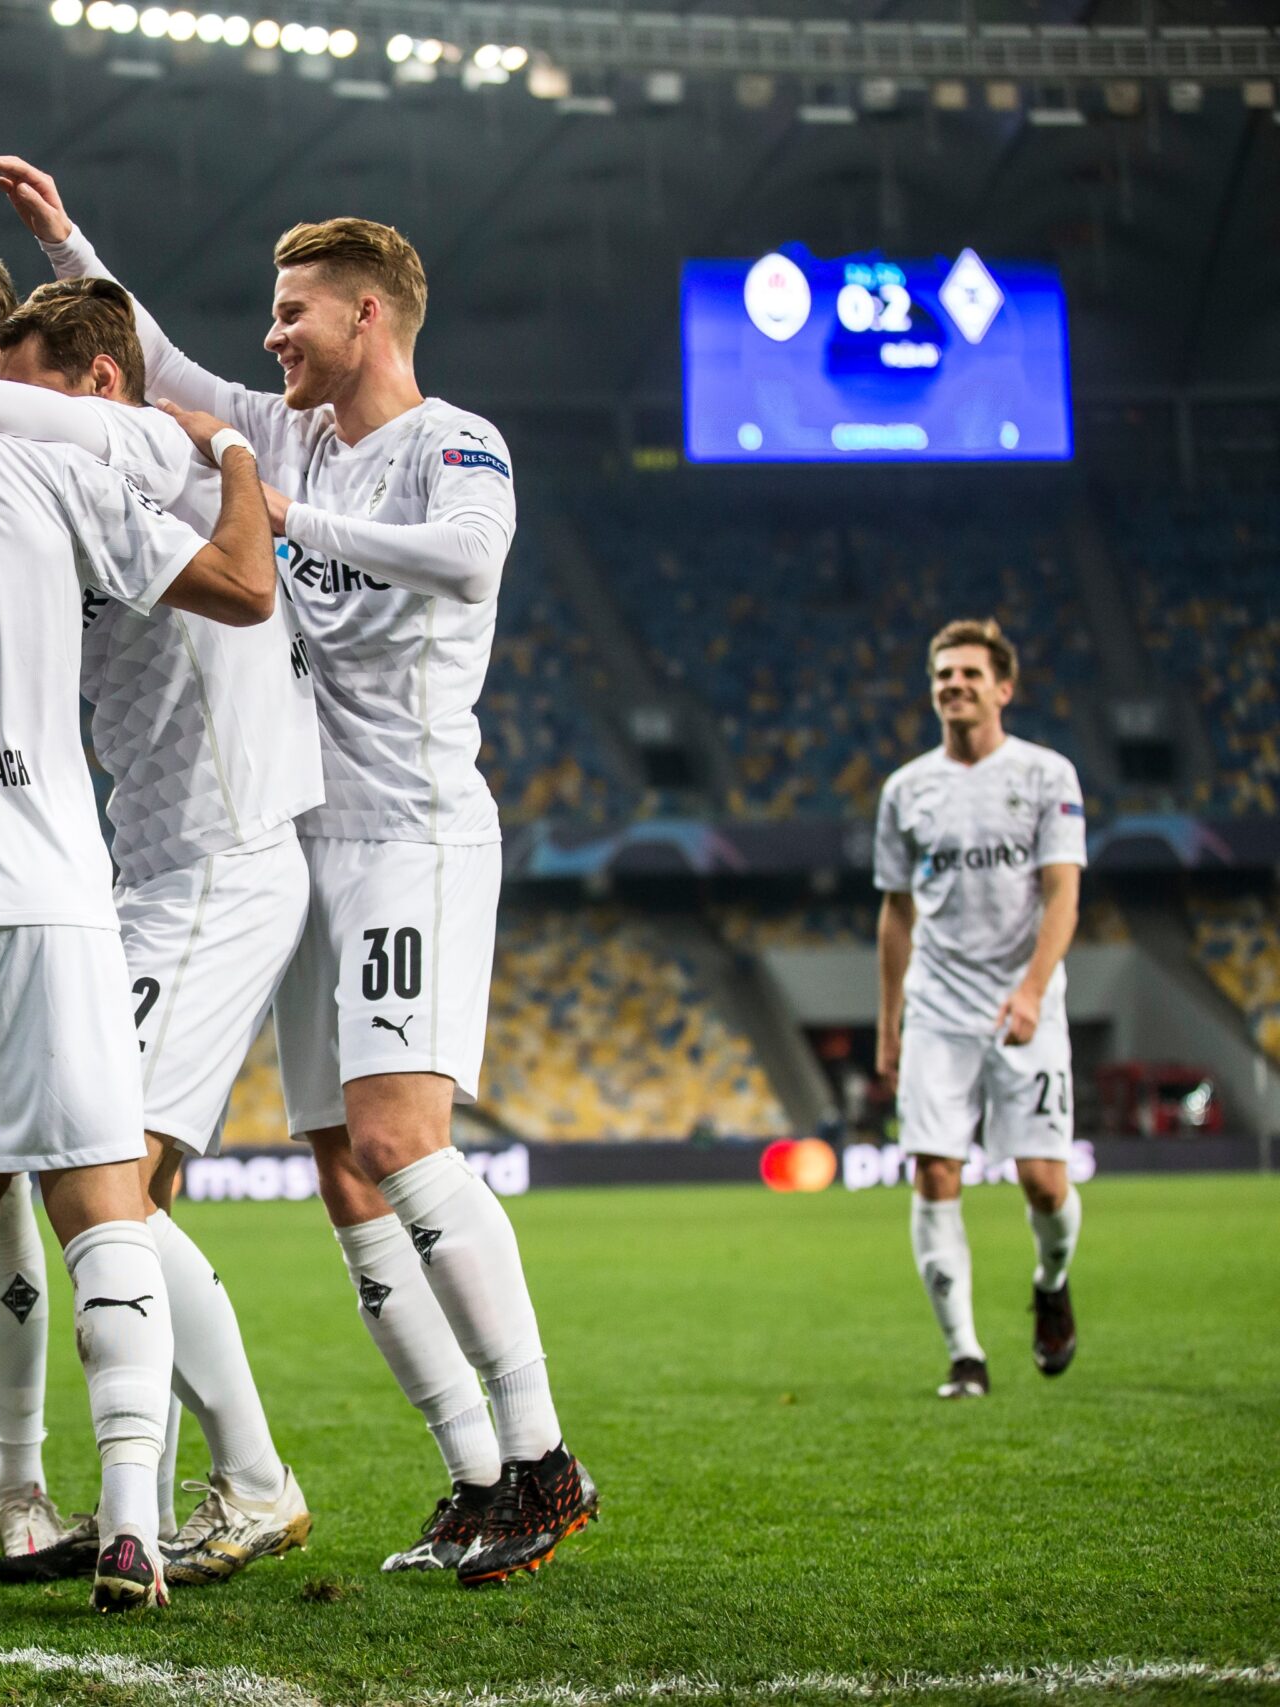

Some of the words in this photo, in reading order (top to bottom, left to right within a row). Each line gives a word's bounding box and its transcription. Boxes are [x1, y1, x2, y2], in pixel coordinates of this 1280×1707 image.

[463, 454, 509, 474] RESPECT
[933, 844, 1029, 874] DEGIRO
[361, 926, 422, 1001] 30
